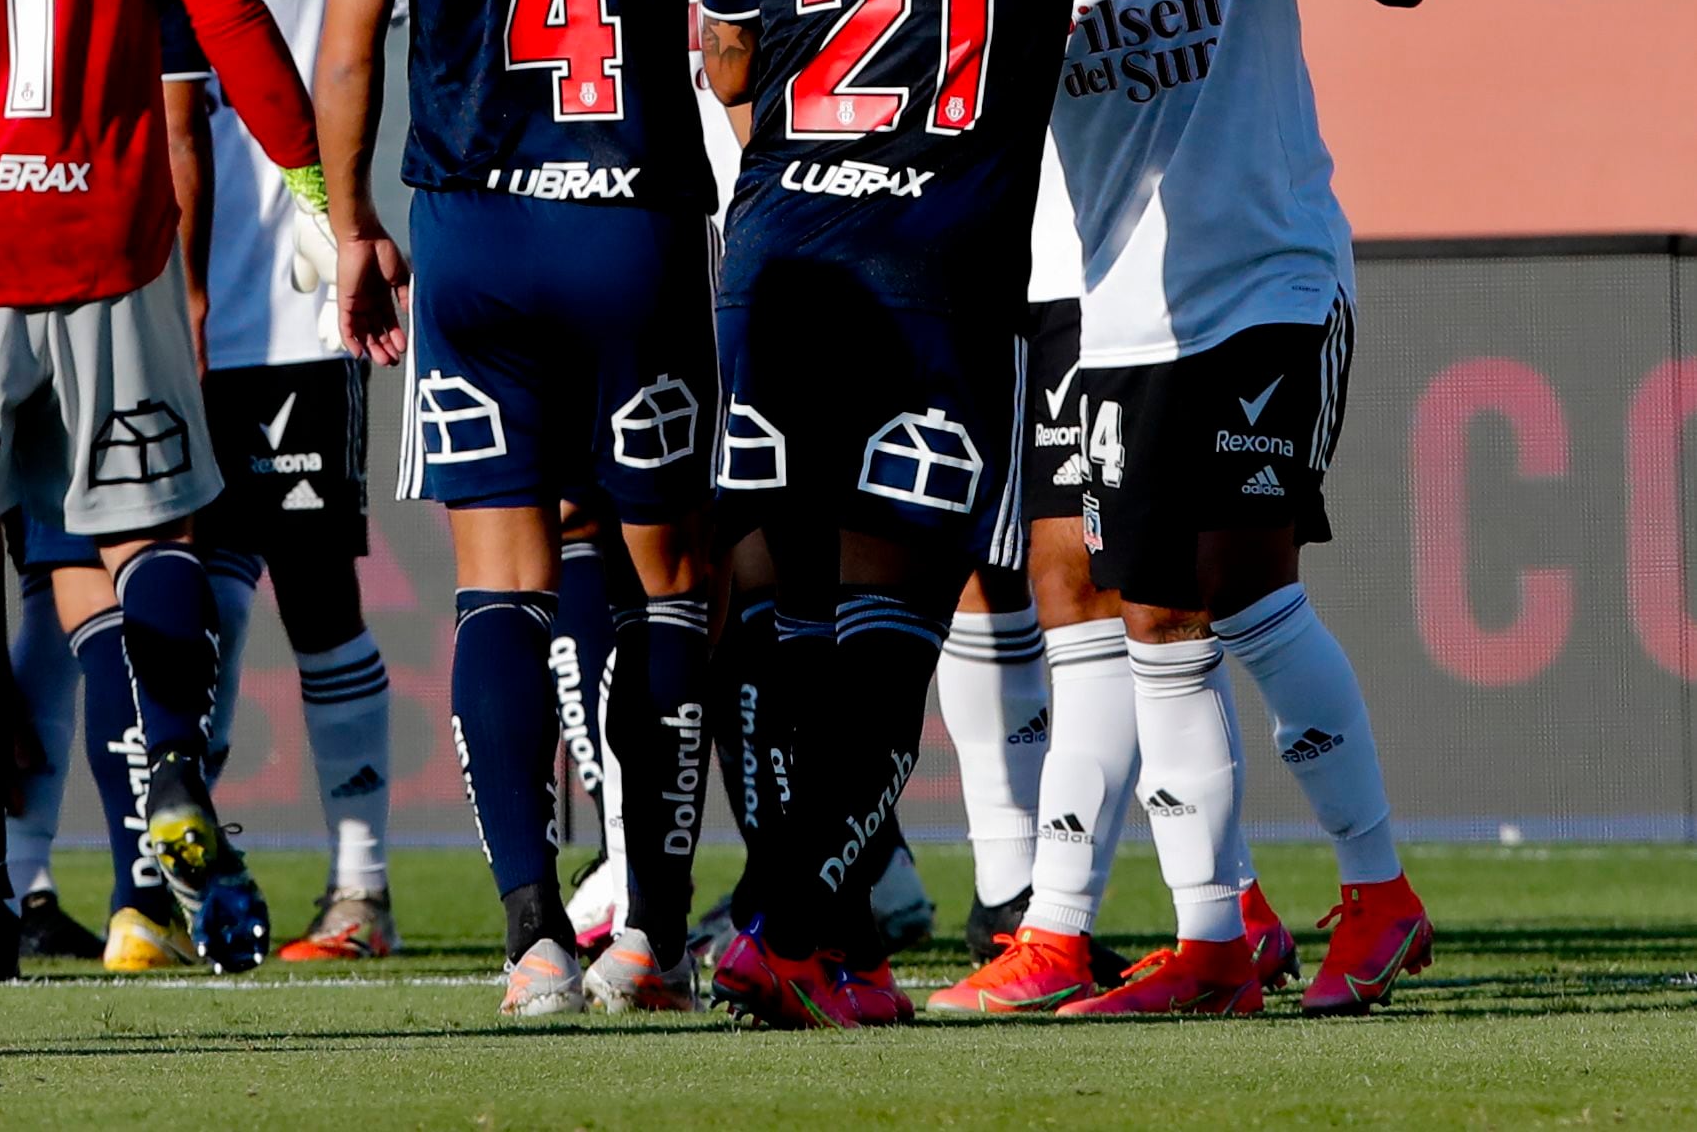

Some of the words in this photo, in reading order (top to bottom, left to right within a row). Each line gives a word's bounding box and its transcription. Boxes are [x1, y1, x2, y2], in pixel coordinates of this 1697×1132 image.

[1064, 57, 1118, 99] del
[1120, 37, 1219, 104] Sur
[780, 159, 936, 199] LUBRAX
[1035, 423, 1081, 448] Rexon
[1216, 430, 1294, 458] Rexona
[1241, 483, 1285, 496] adidas
[1008, 732, 1048, 745] adid
[1281, 734, 1345, 764] adidas
[660, 702, 703, 856] Dolorub
[819, 749, 913, 894] Dolorub
